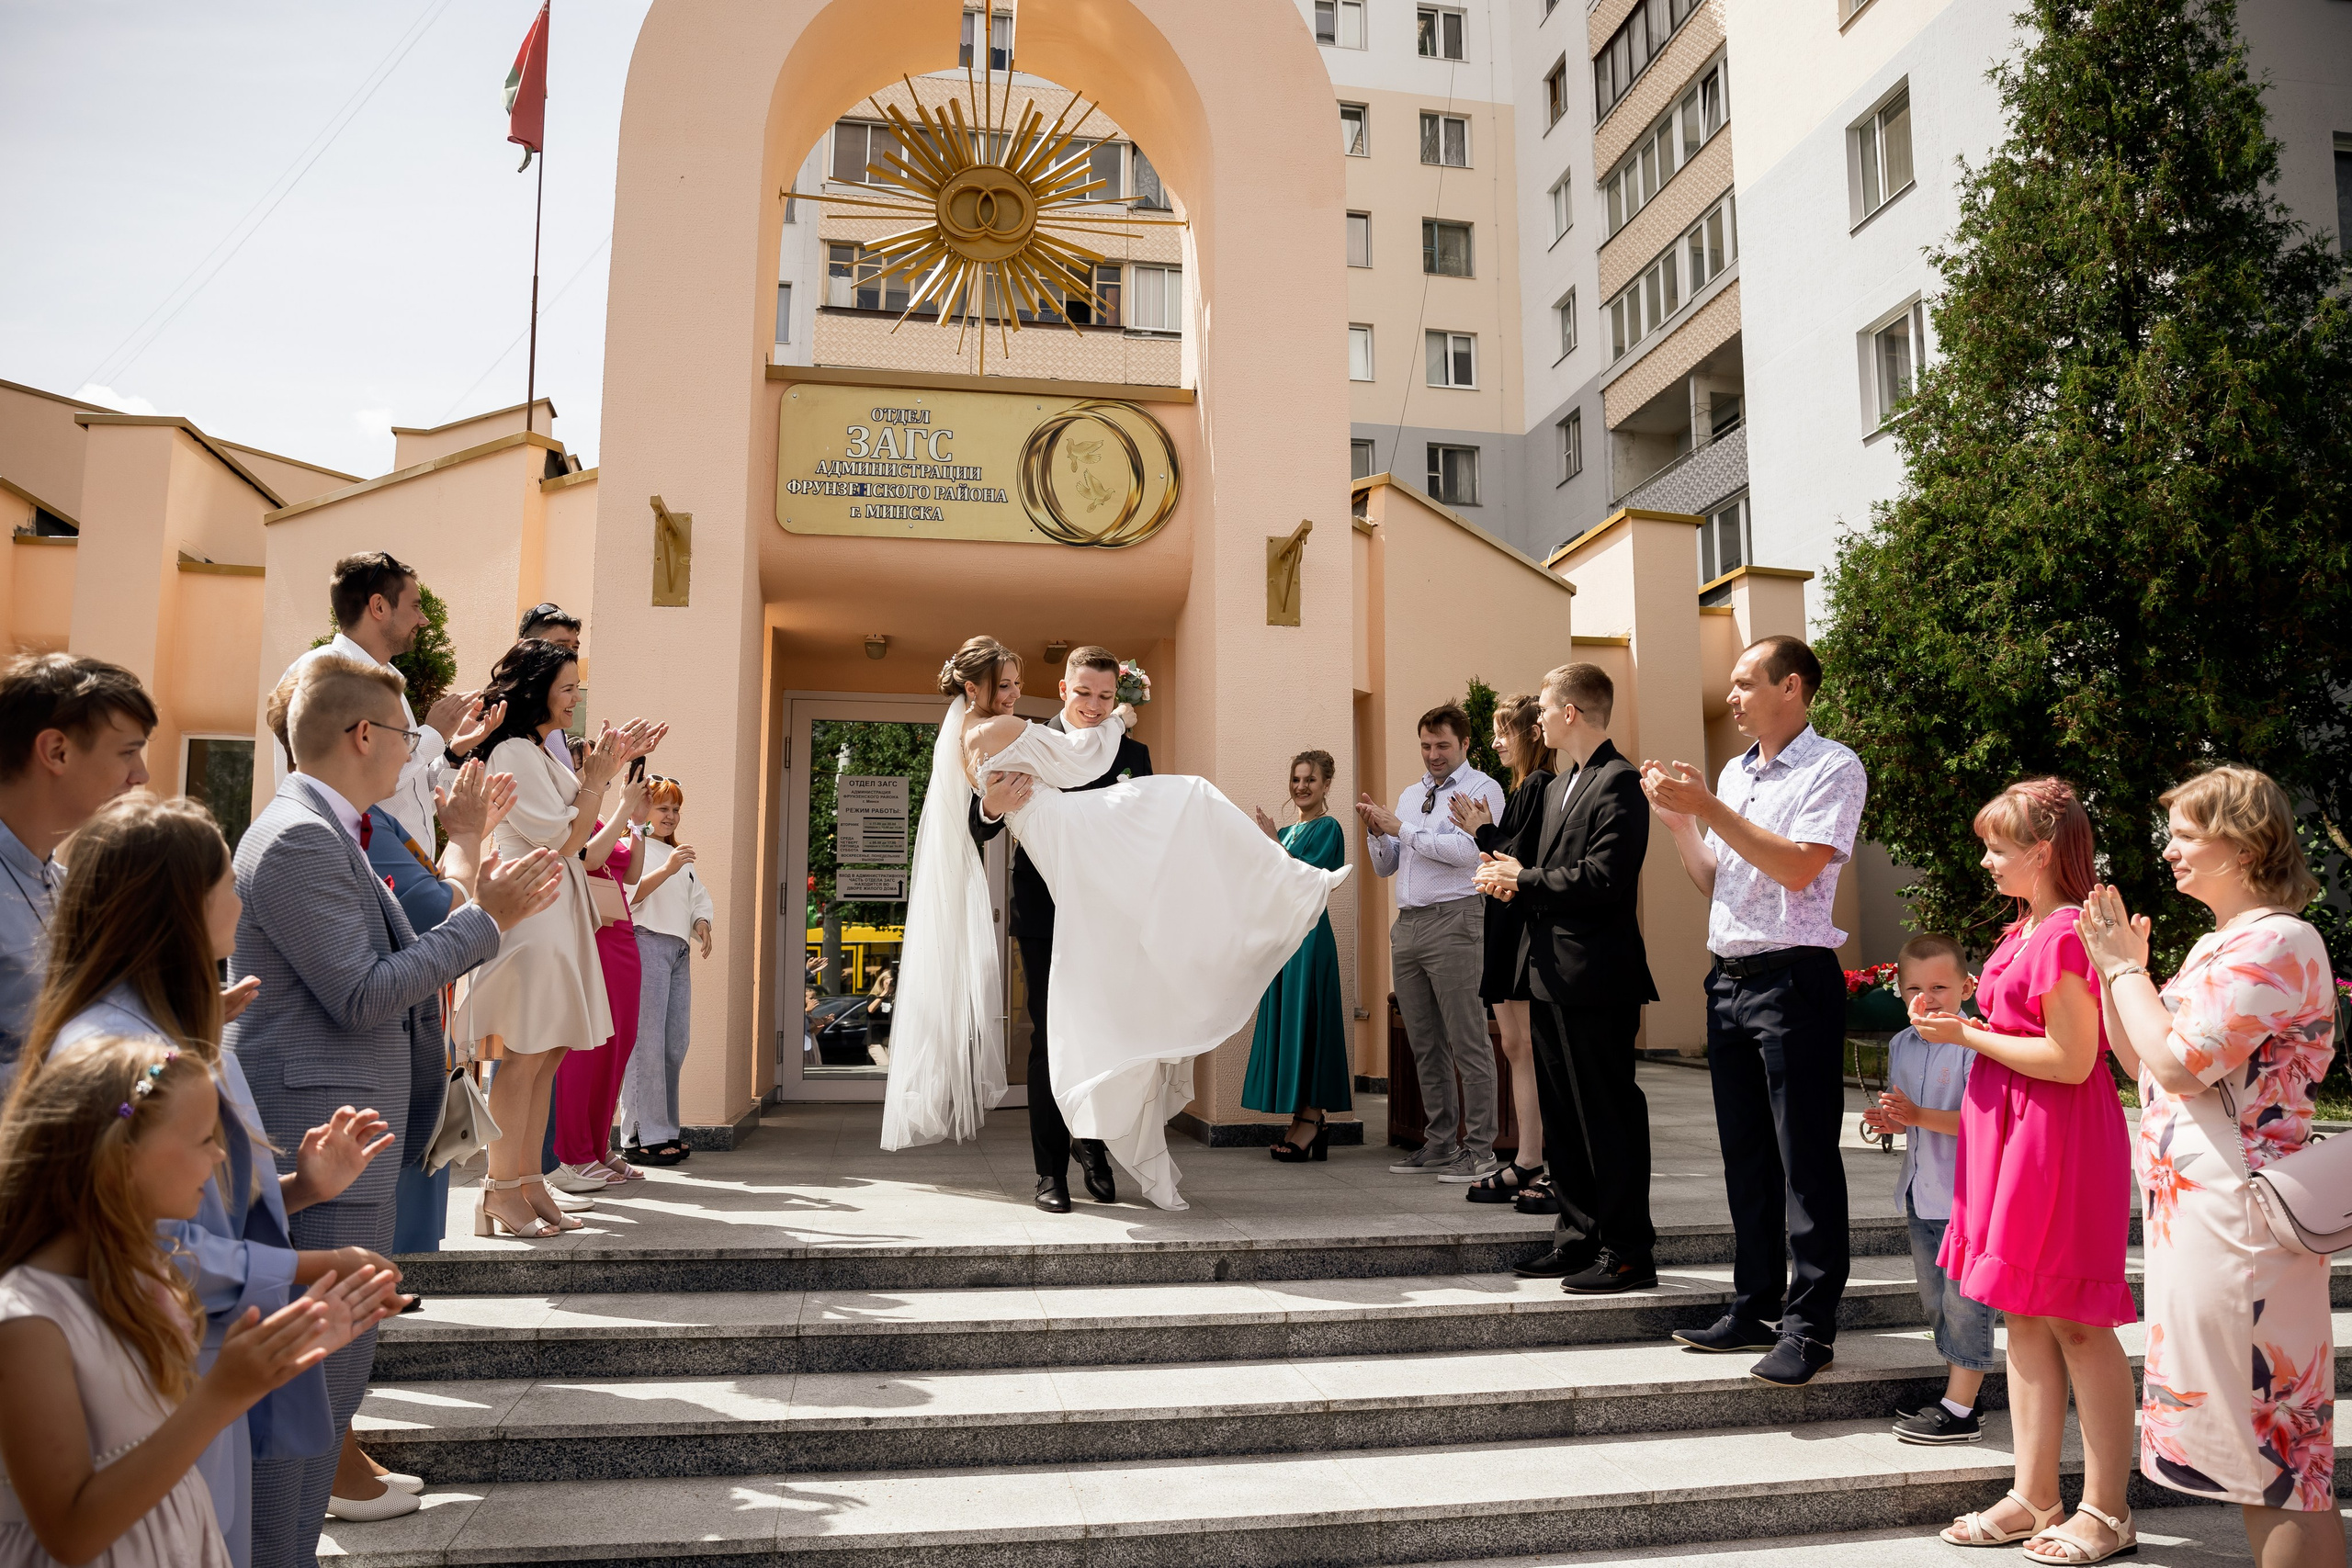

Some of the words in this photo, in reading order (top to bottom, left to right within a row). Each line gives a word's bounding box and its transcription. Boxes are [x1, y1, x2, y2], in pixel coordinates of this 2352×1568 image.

[871, 407, 931, 425] ОТДЕЛ
[845, 425, 954, 462] ЗАГС
[815, 459, 982, 482] АДМИНИСТРАЦИИ
[786, 479, 930, 500] ФРУНЗЕНСКОГО
[934, 484, 1008, 503] РАЙОНА
[850, 506, 861, 518] г.
[865, 504, 944, 521] МИНСКА
